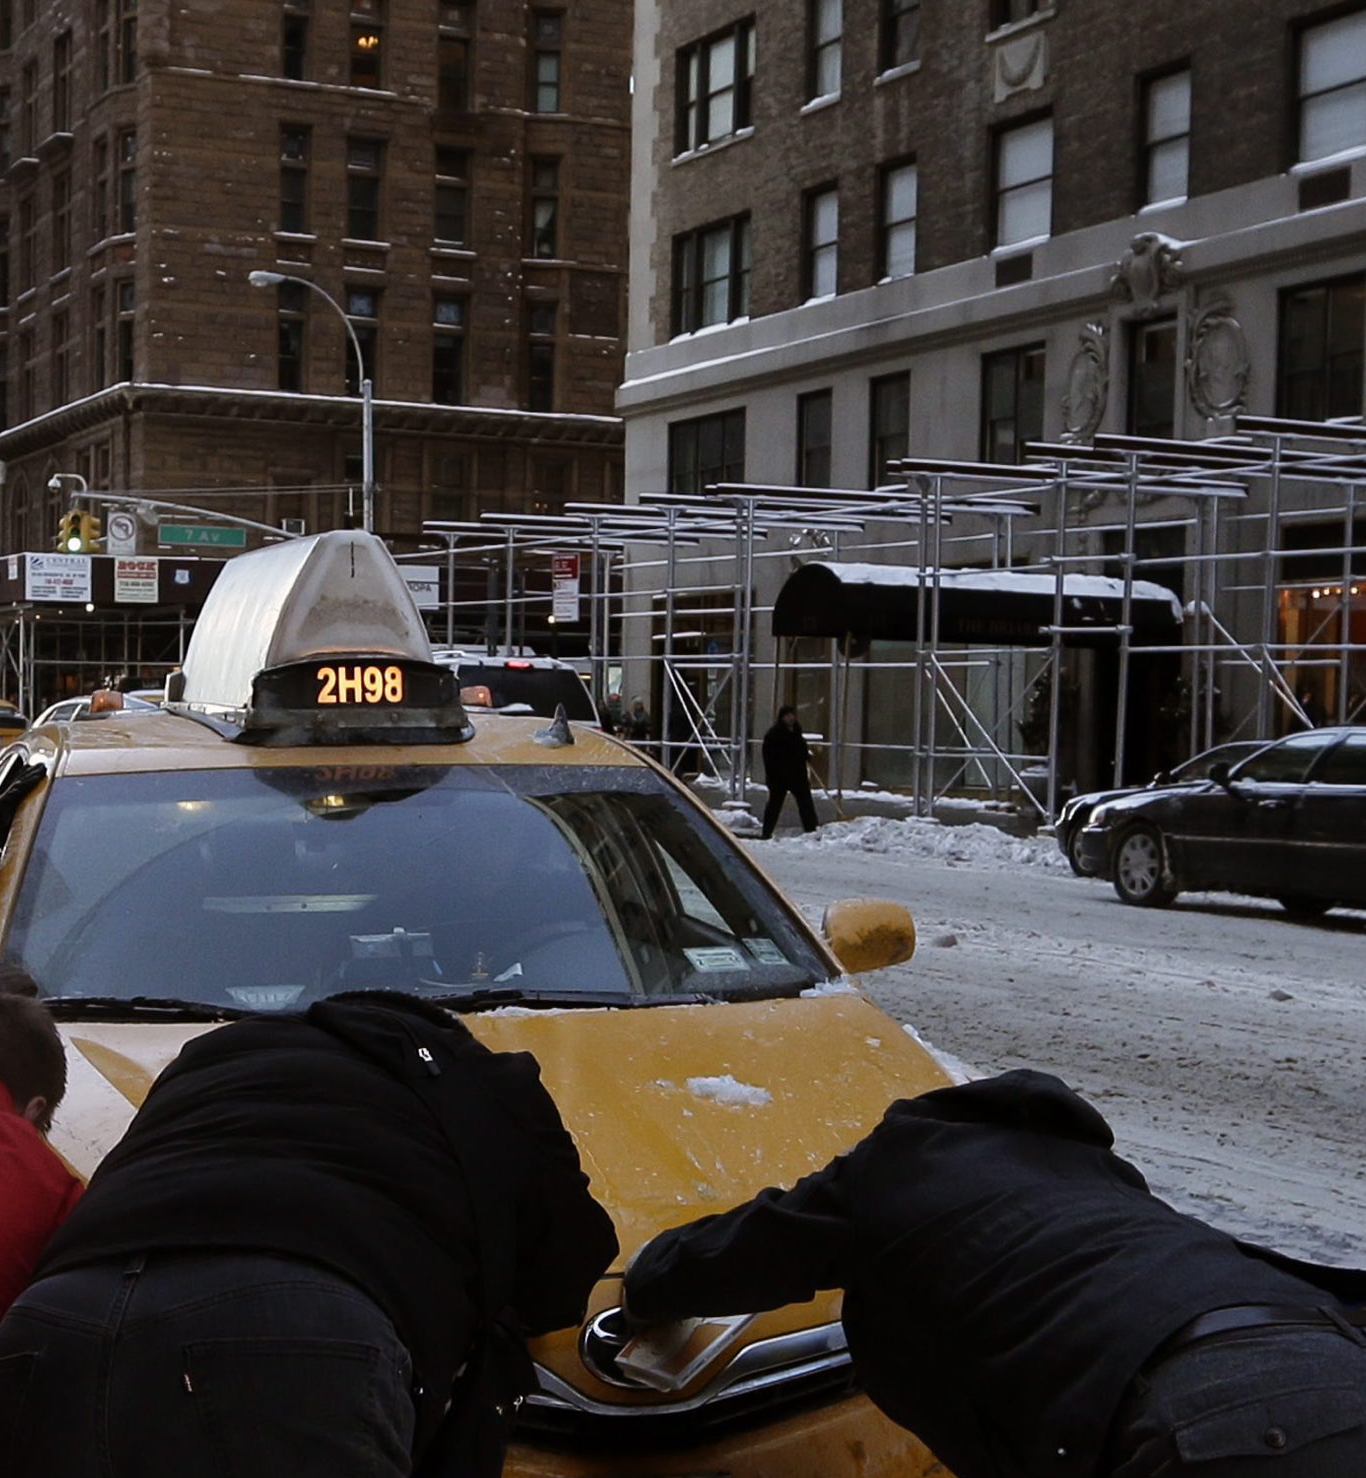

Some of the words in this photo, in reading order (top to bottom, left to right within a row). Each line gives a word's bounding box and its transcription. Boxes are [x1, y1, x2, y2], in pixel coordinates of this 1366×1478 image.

[184, 528, 194, 541] 7
[198, 529, 222, 543] Av
[316, 665, 404, 704] 2H98
